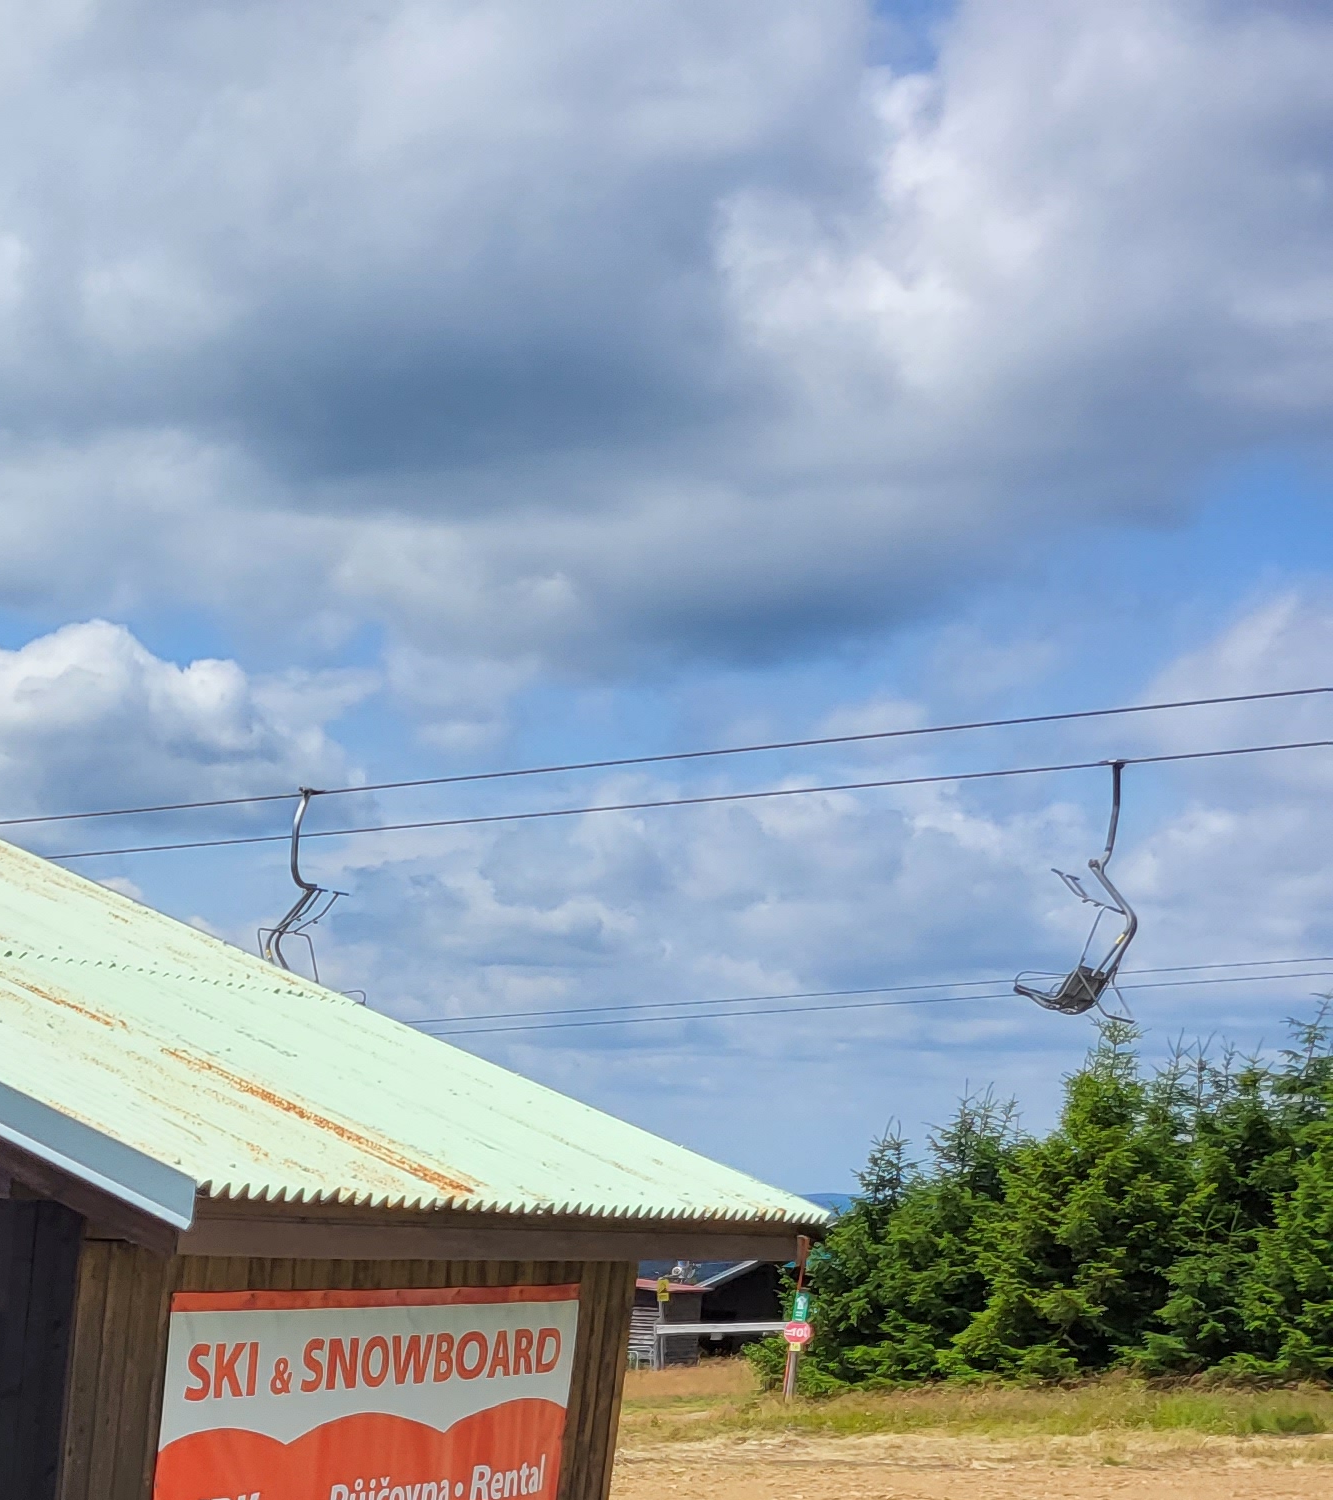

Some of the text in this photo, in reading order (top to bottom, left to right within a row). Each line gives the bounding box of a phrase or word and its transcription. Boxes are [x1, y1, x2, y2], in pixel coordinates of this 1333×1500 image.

[183, 1327, 562, 1402] SKI & SNOWBOARD
